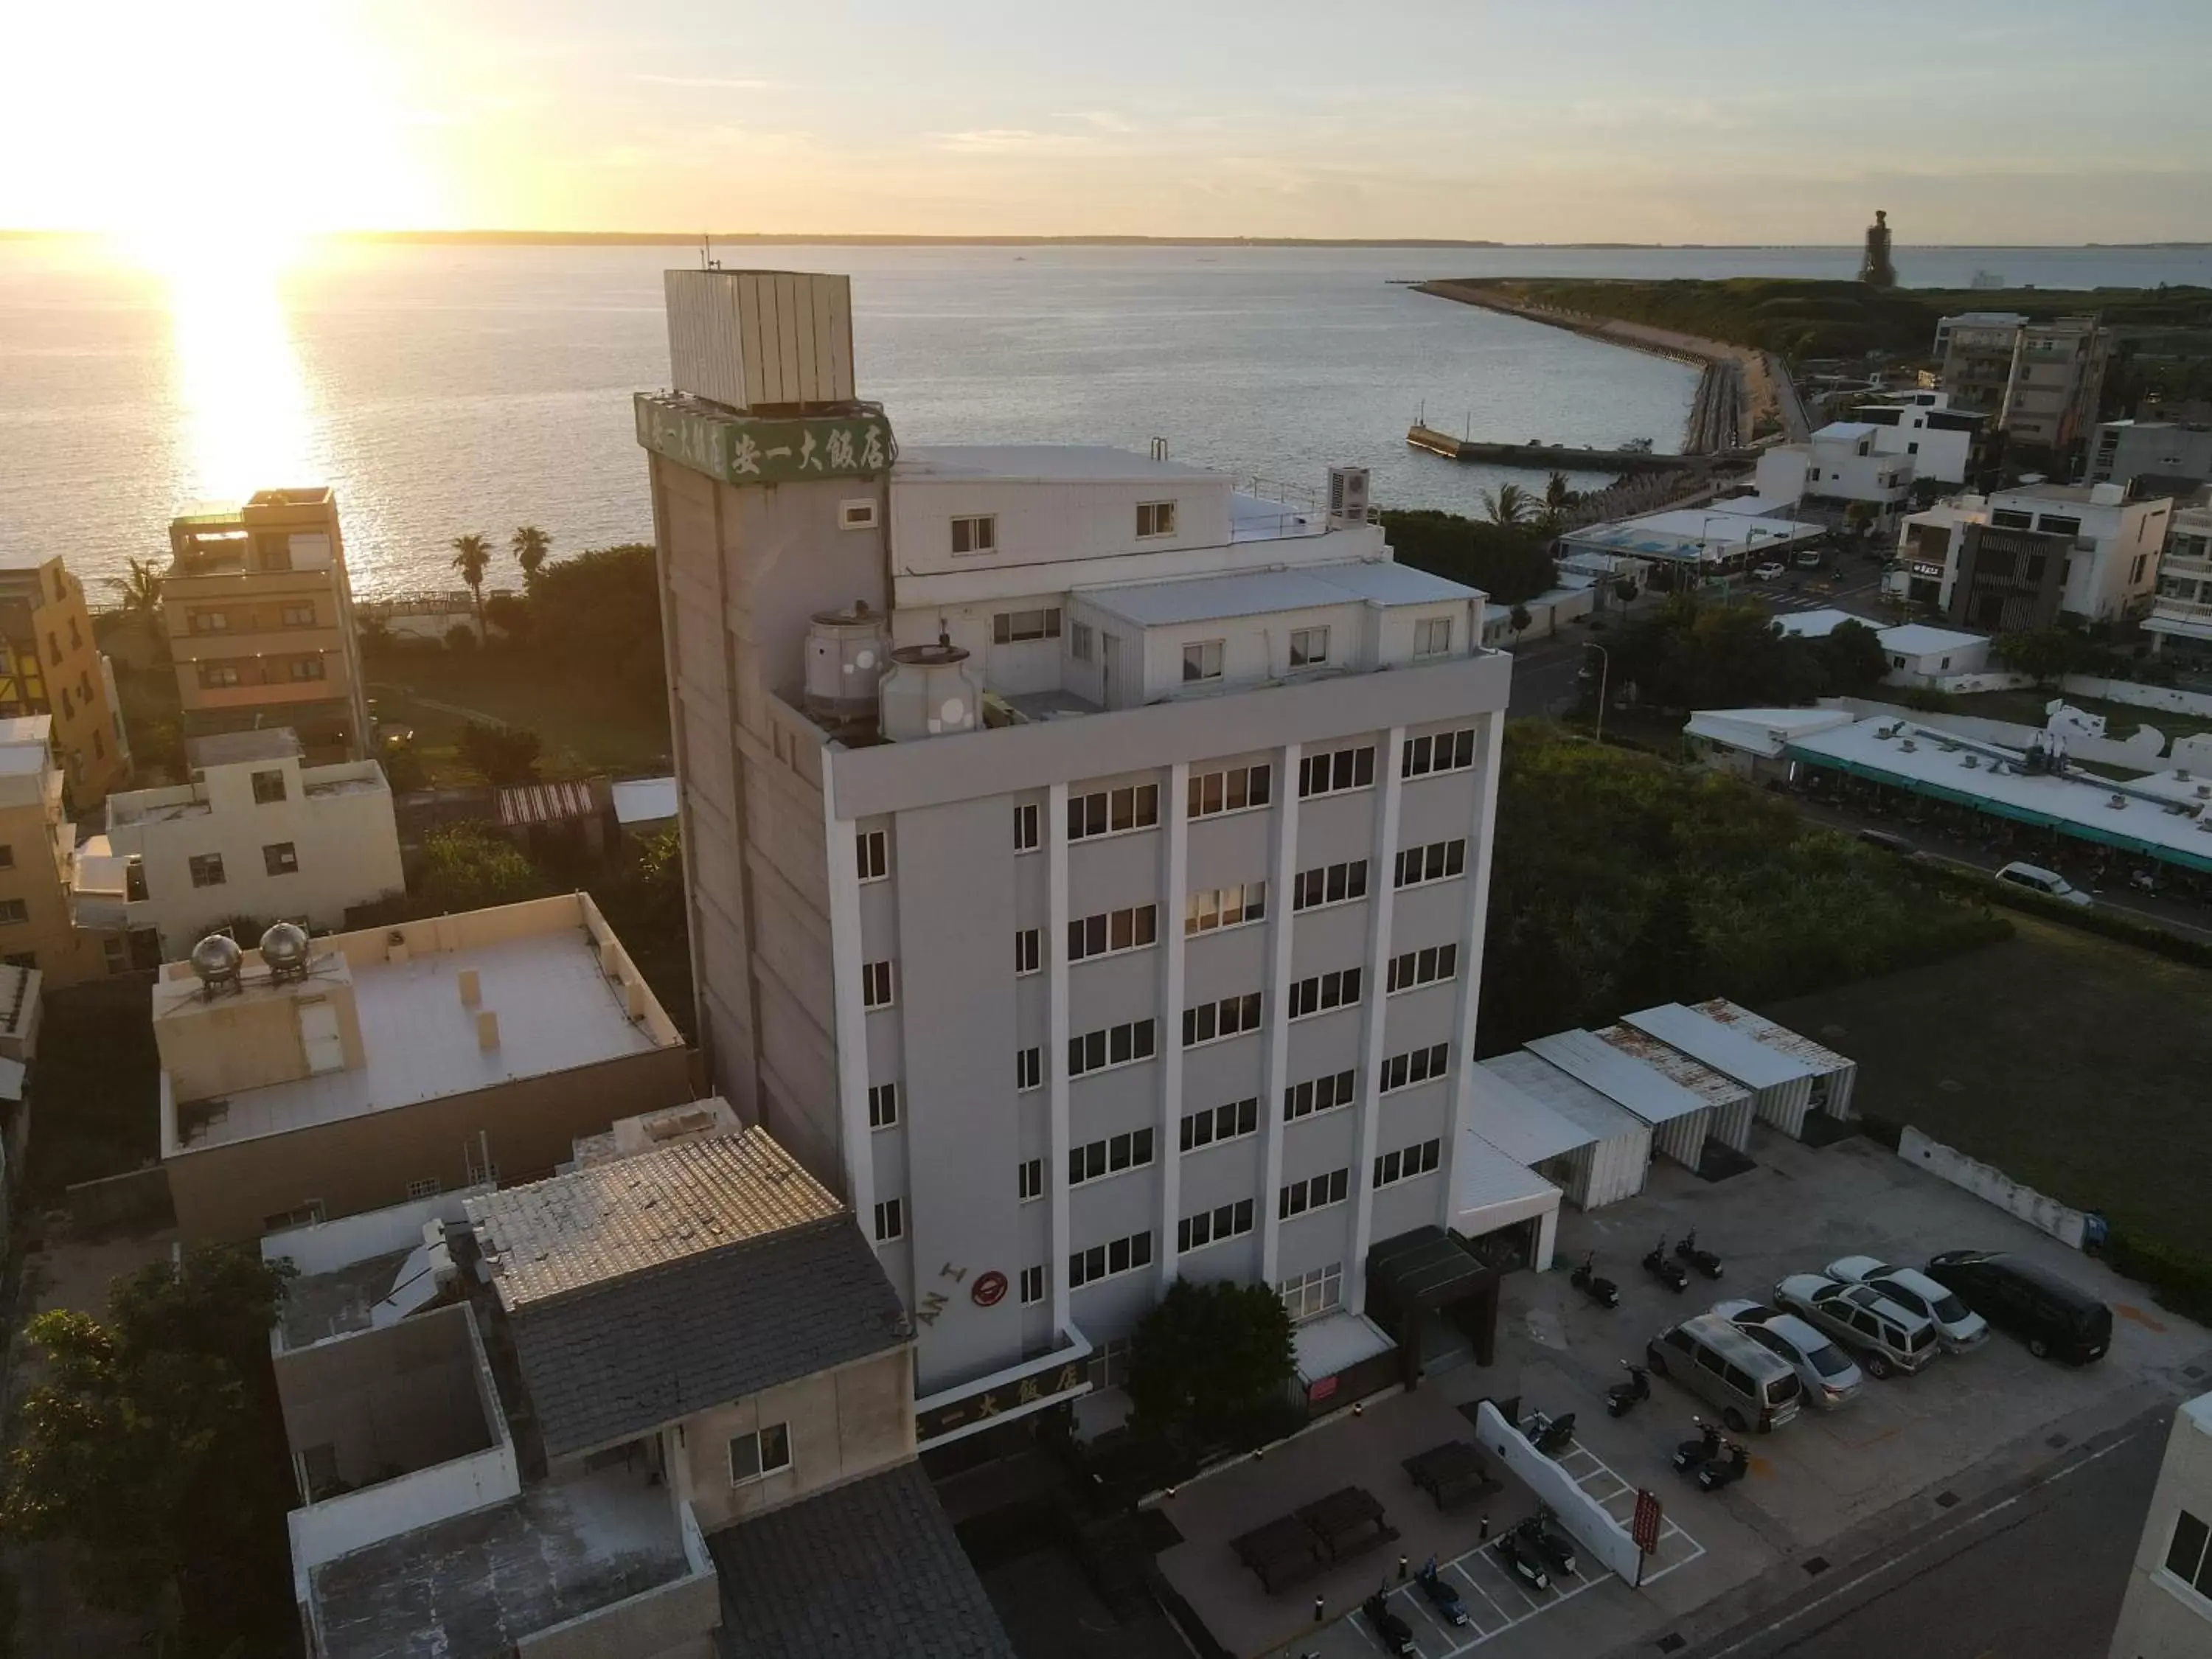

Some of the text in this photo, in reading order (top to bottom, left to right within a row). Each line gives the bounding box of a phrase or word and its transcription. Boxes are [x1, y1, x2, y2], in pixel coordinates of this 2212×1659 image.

[733, 425, 884, 474] 安一大飯店
